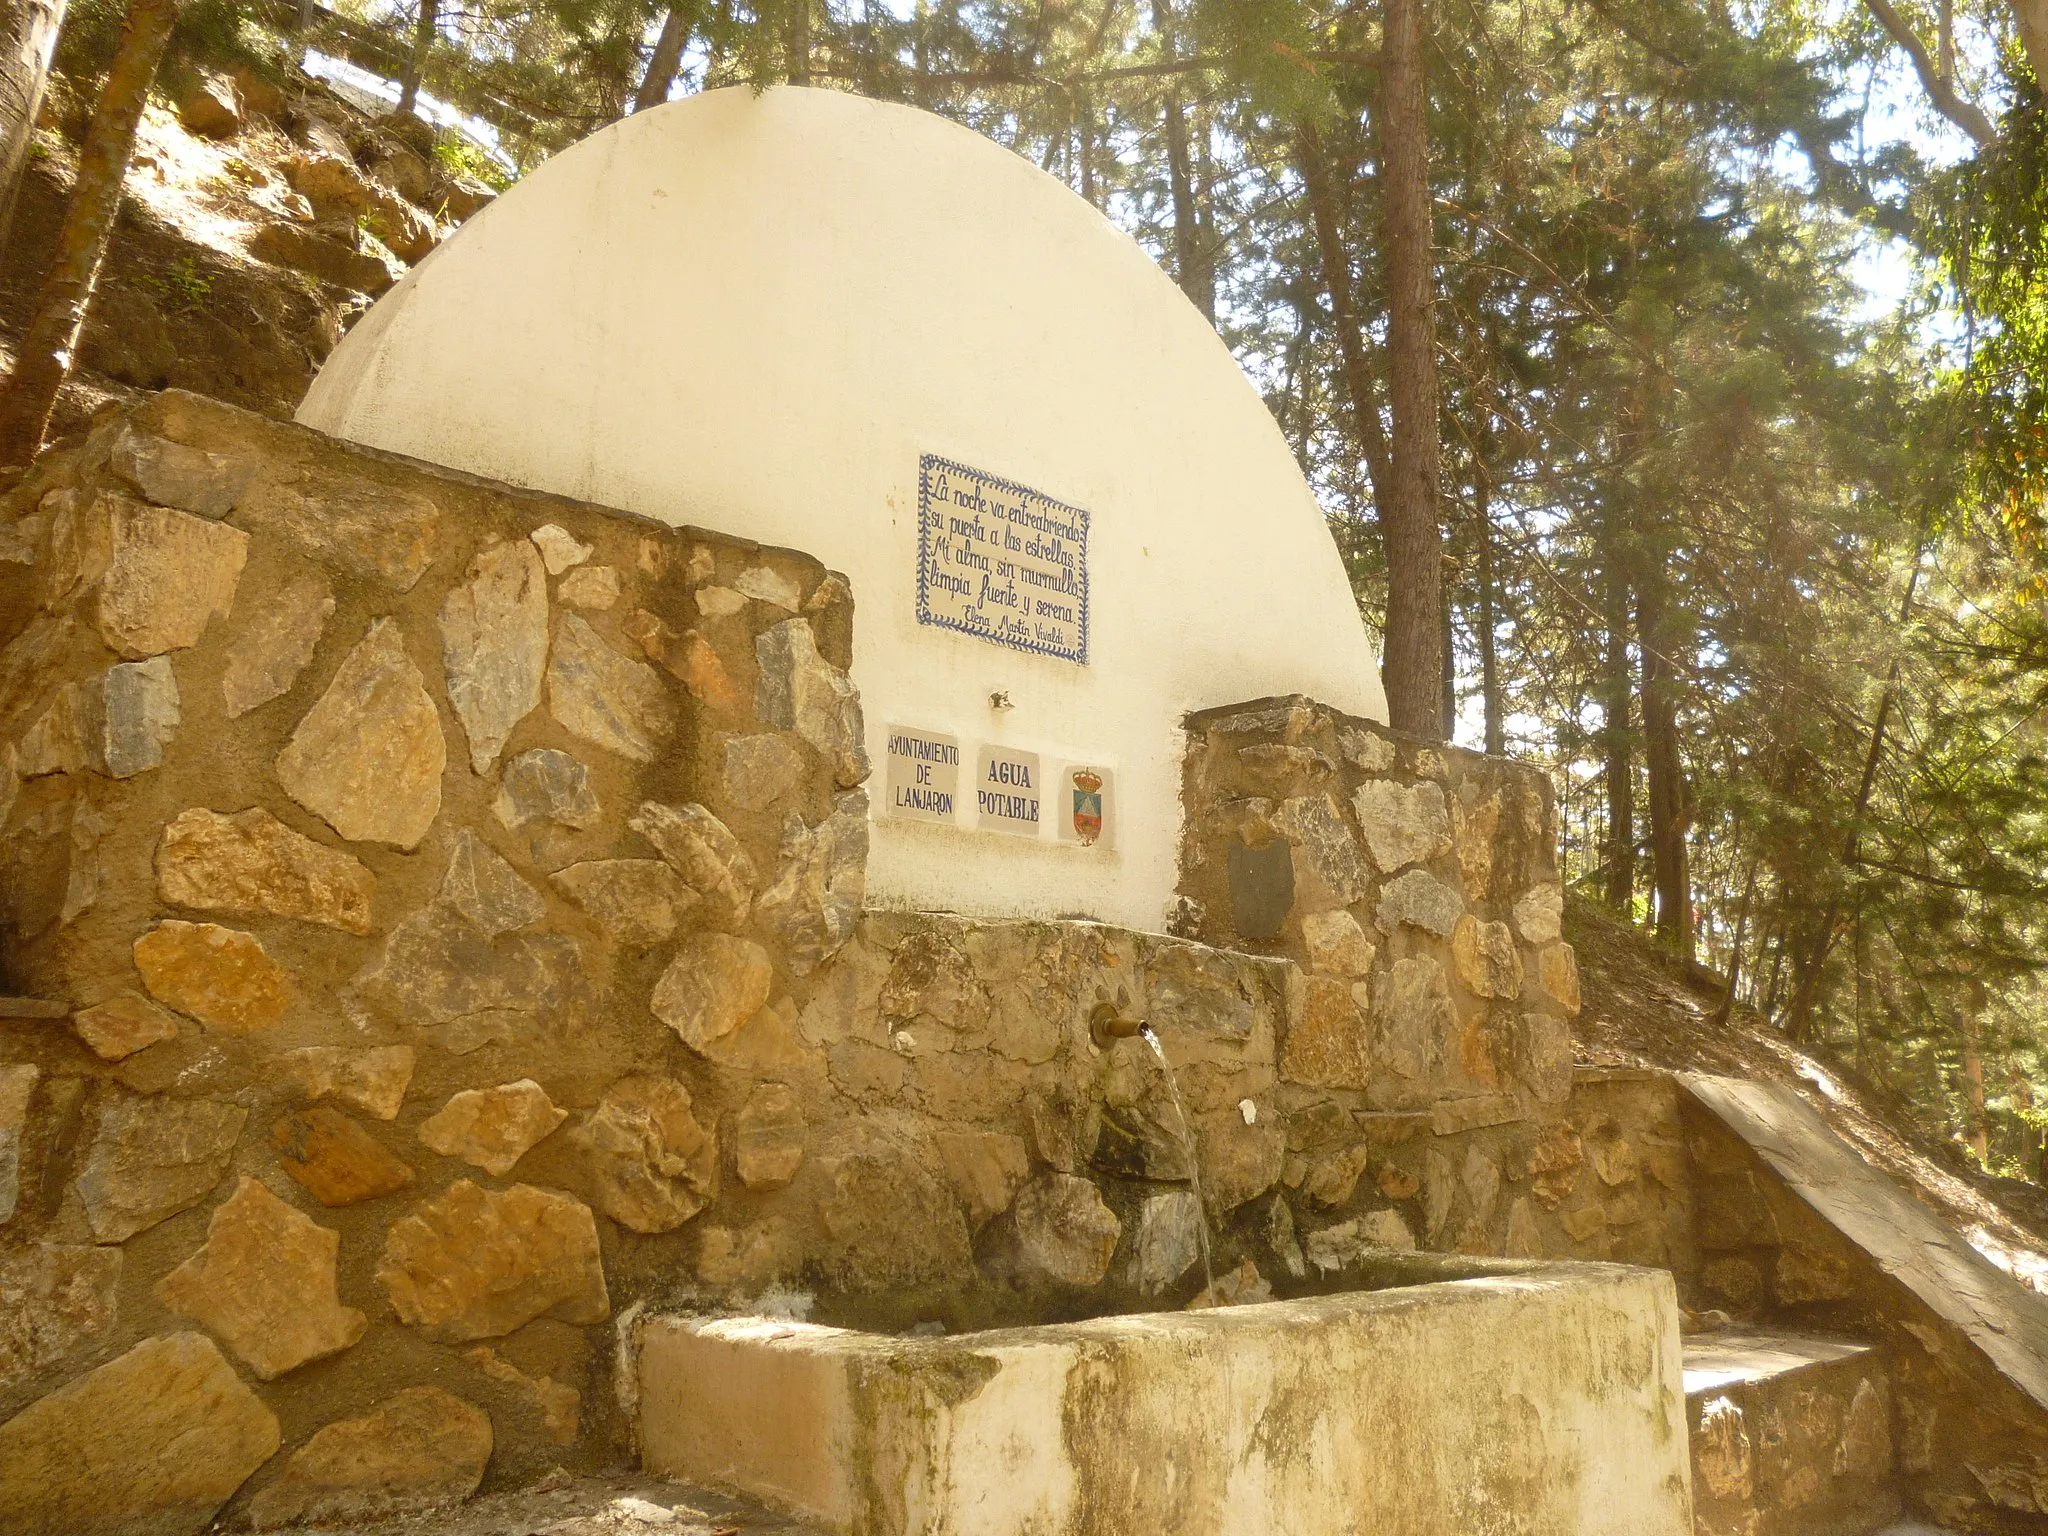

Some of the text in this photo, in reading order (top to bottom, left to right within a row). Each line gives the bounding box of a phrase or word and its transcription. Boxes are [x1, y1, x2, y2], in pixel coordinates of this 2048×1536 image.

[930, 474, 1079, 542] La noche va entreabriendo
[931, 511, 1075, 570] su puerta a las estrellas.
[931, 536, 1079, 600] Mi alma, sin murmullo,
[930, 560, 1076, 624] limpia fuente y serena.
[962, 605, 1063, 645] Elena Martín Vivaldi
[888, 735, 959, 765] AYUNTAMIENTO
[917, 764, 931, 785] DE
[988, 760, 1031, 788] AGUA
[896, 786, 952, 815] LANJARON
[977, 790, 1039, 822] POTABLE
